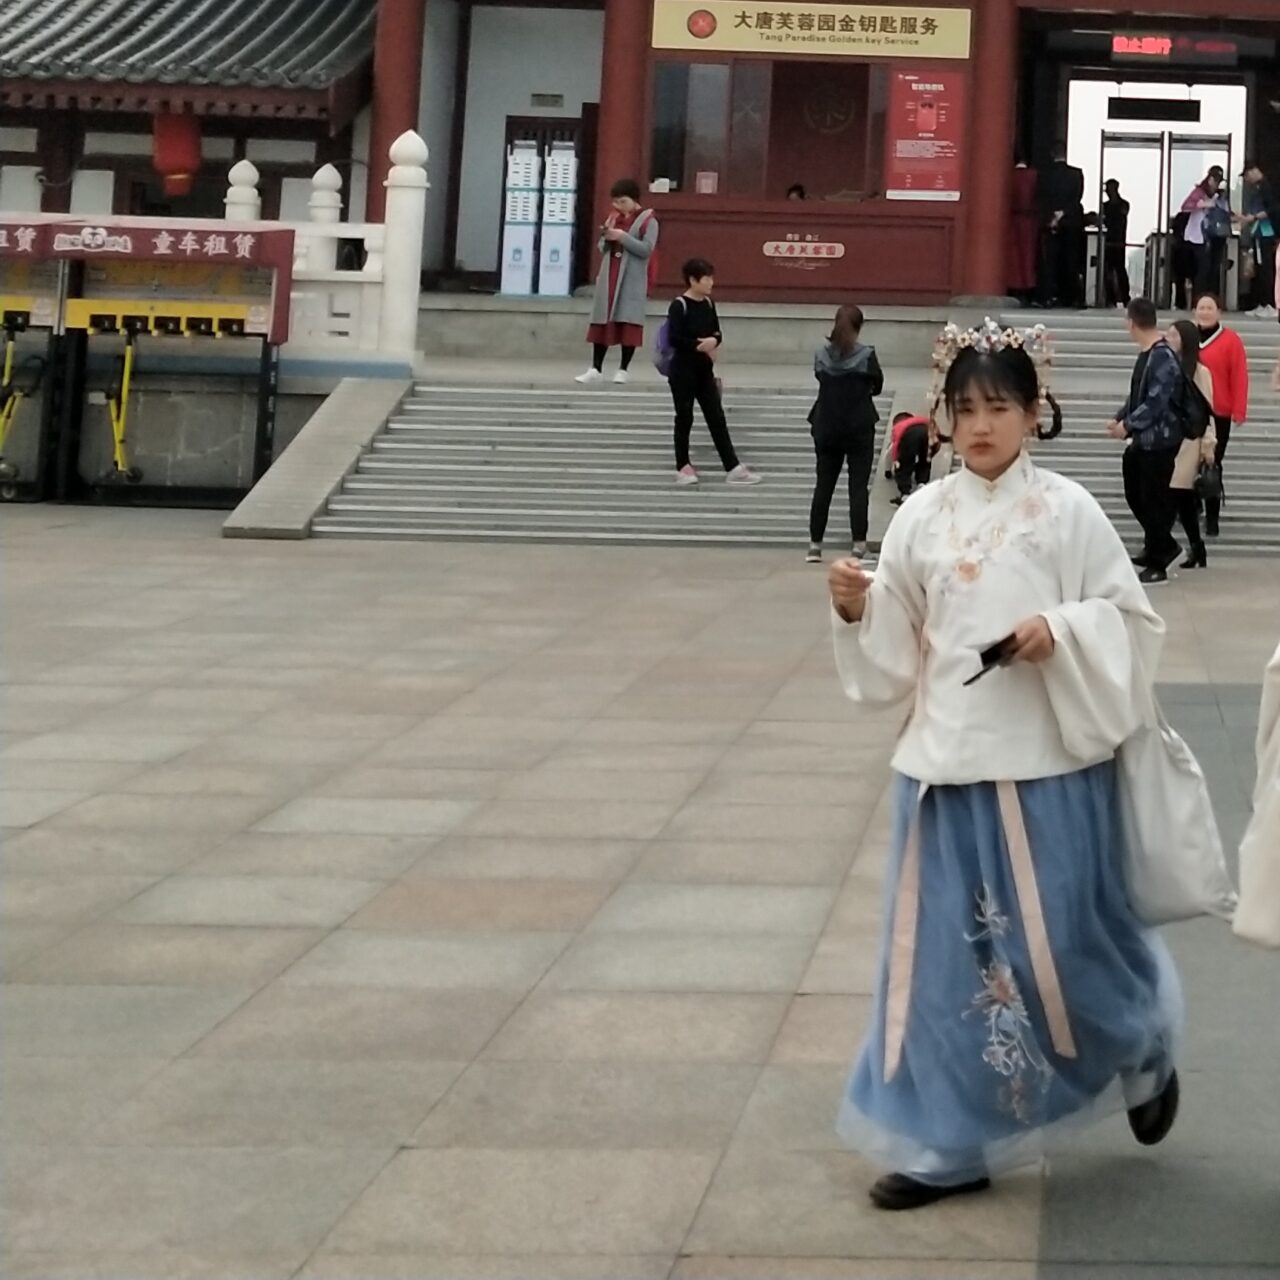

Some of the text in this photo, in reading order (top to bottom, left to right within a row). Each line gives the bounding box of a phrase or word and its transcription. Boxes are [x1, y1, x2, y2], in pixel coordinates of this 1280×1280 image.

[734, 11, 939, 35] 大唐芙蓉园金钥匙服务
[760, 32, 783, 42] Tang
[785, 33, 826, 42] Paradise
[829, 35, 863, 43] Golden
[884, 36, 919, 46] Service
[152, 230, 256, 259] 童车租赁
